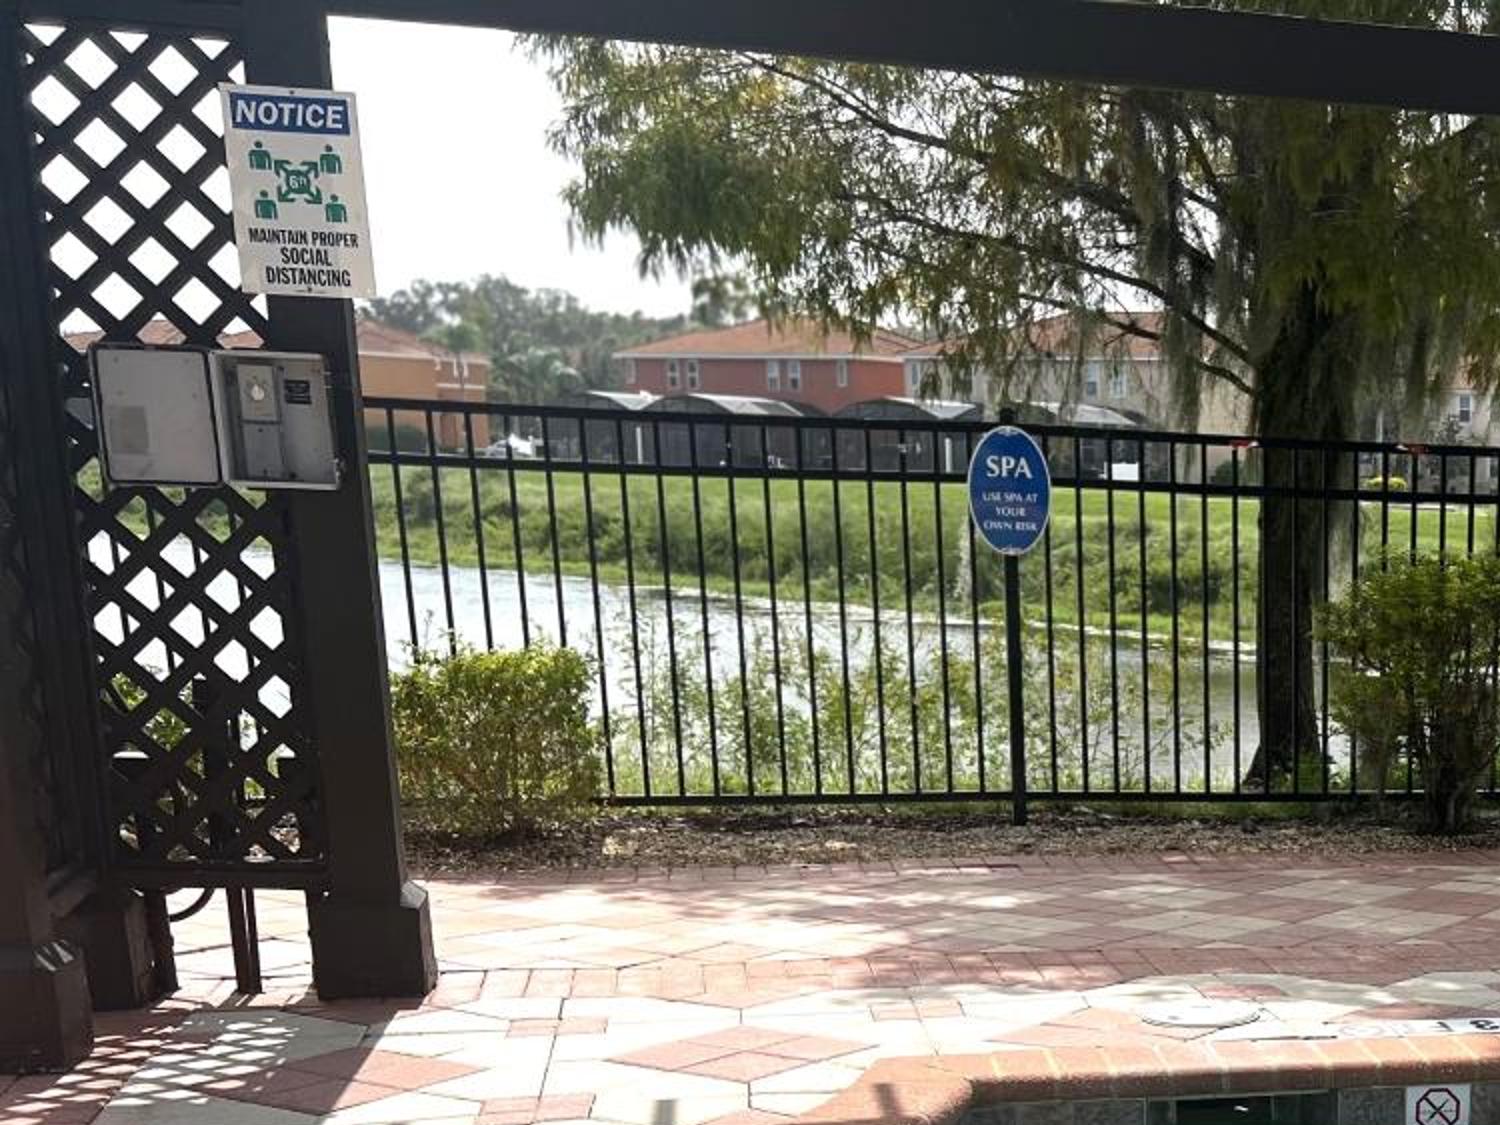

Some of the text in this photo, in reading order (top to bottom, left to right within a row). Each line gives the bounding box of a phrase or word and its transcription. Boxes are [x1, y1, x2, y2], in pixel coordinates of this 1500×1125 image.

[235, 99, 345, 130] NOTICE
[248, 227, 359, 249] MAINTAIN PROPER
[280, 246, 333, 267] SOCIAL
[265, 266, 351, 287] DISTANCING
[985, 455, 1032, 479] SPA
[982, 491, 1039, 503] USE SPA AT
[995, 506, 1026, 517] YOUR
[983, 521, 1038, 531] OWN RISK
